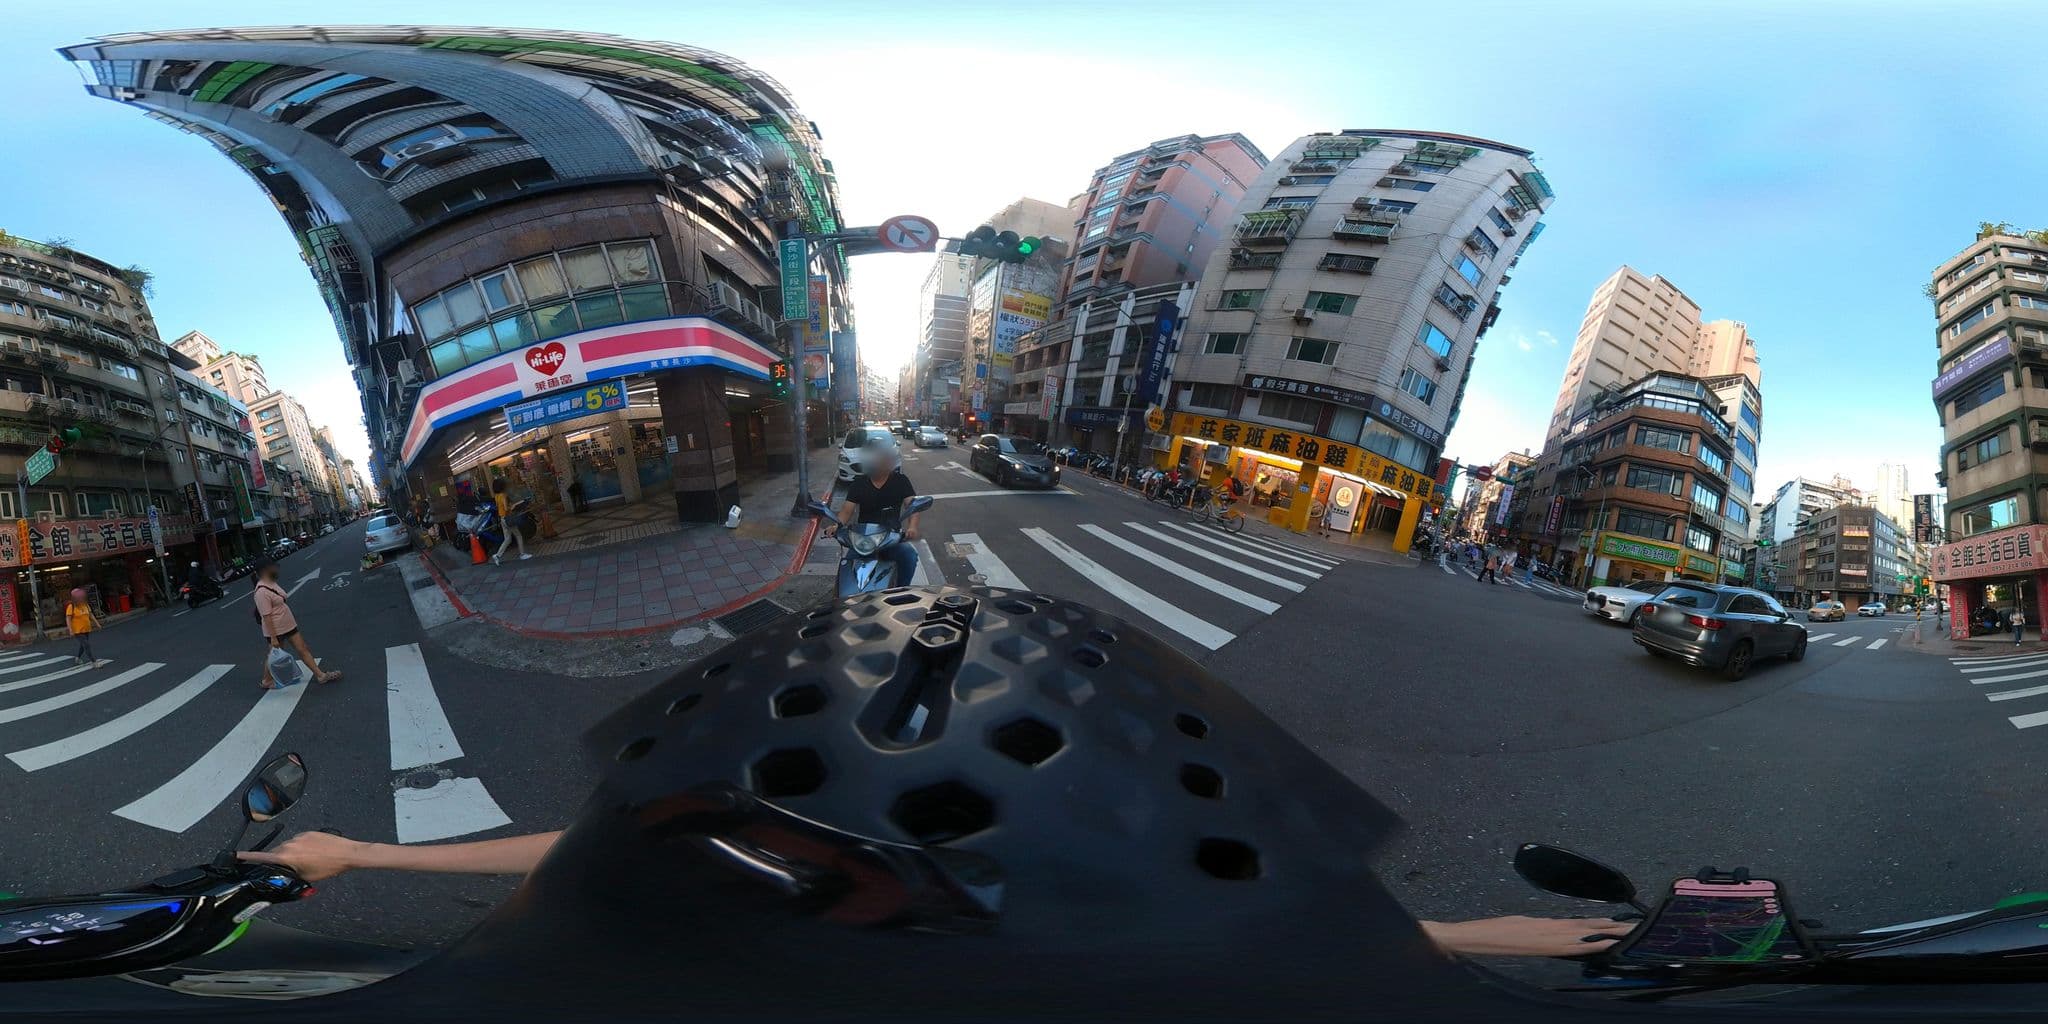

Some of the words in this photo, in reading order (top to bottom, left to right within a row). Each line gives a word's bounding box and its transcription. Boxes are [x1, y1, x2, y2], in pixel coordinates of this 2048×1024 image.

[787, 245, 800, 287] 長沙街二段
[531, 351, 563, 367] Hi-Life
[774, 364, 787, 378] 35
[534, 373, 573, 391] 萊爾富
[586, 383, 619, 410] 5%
[1200, 419, 1348, 468] 莊家班麻油雞
[1380, 464, 1431, 498] 麻油雞
[29, 521, 154, 559] 全館生活百貨
[1951, 532, 2033, 568] 全館生活百貨
